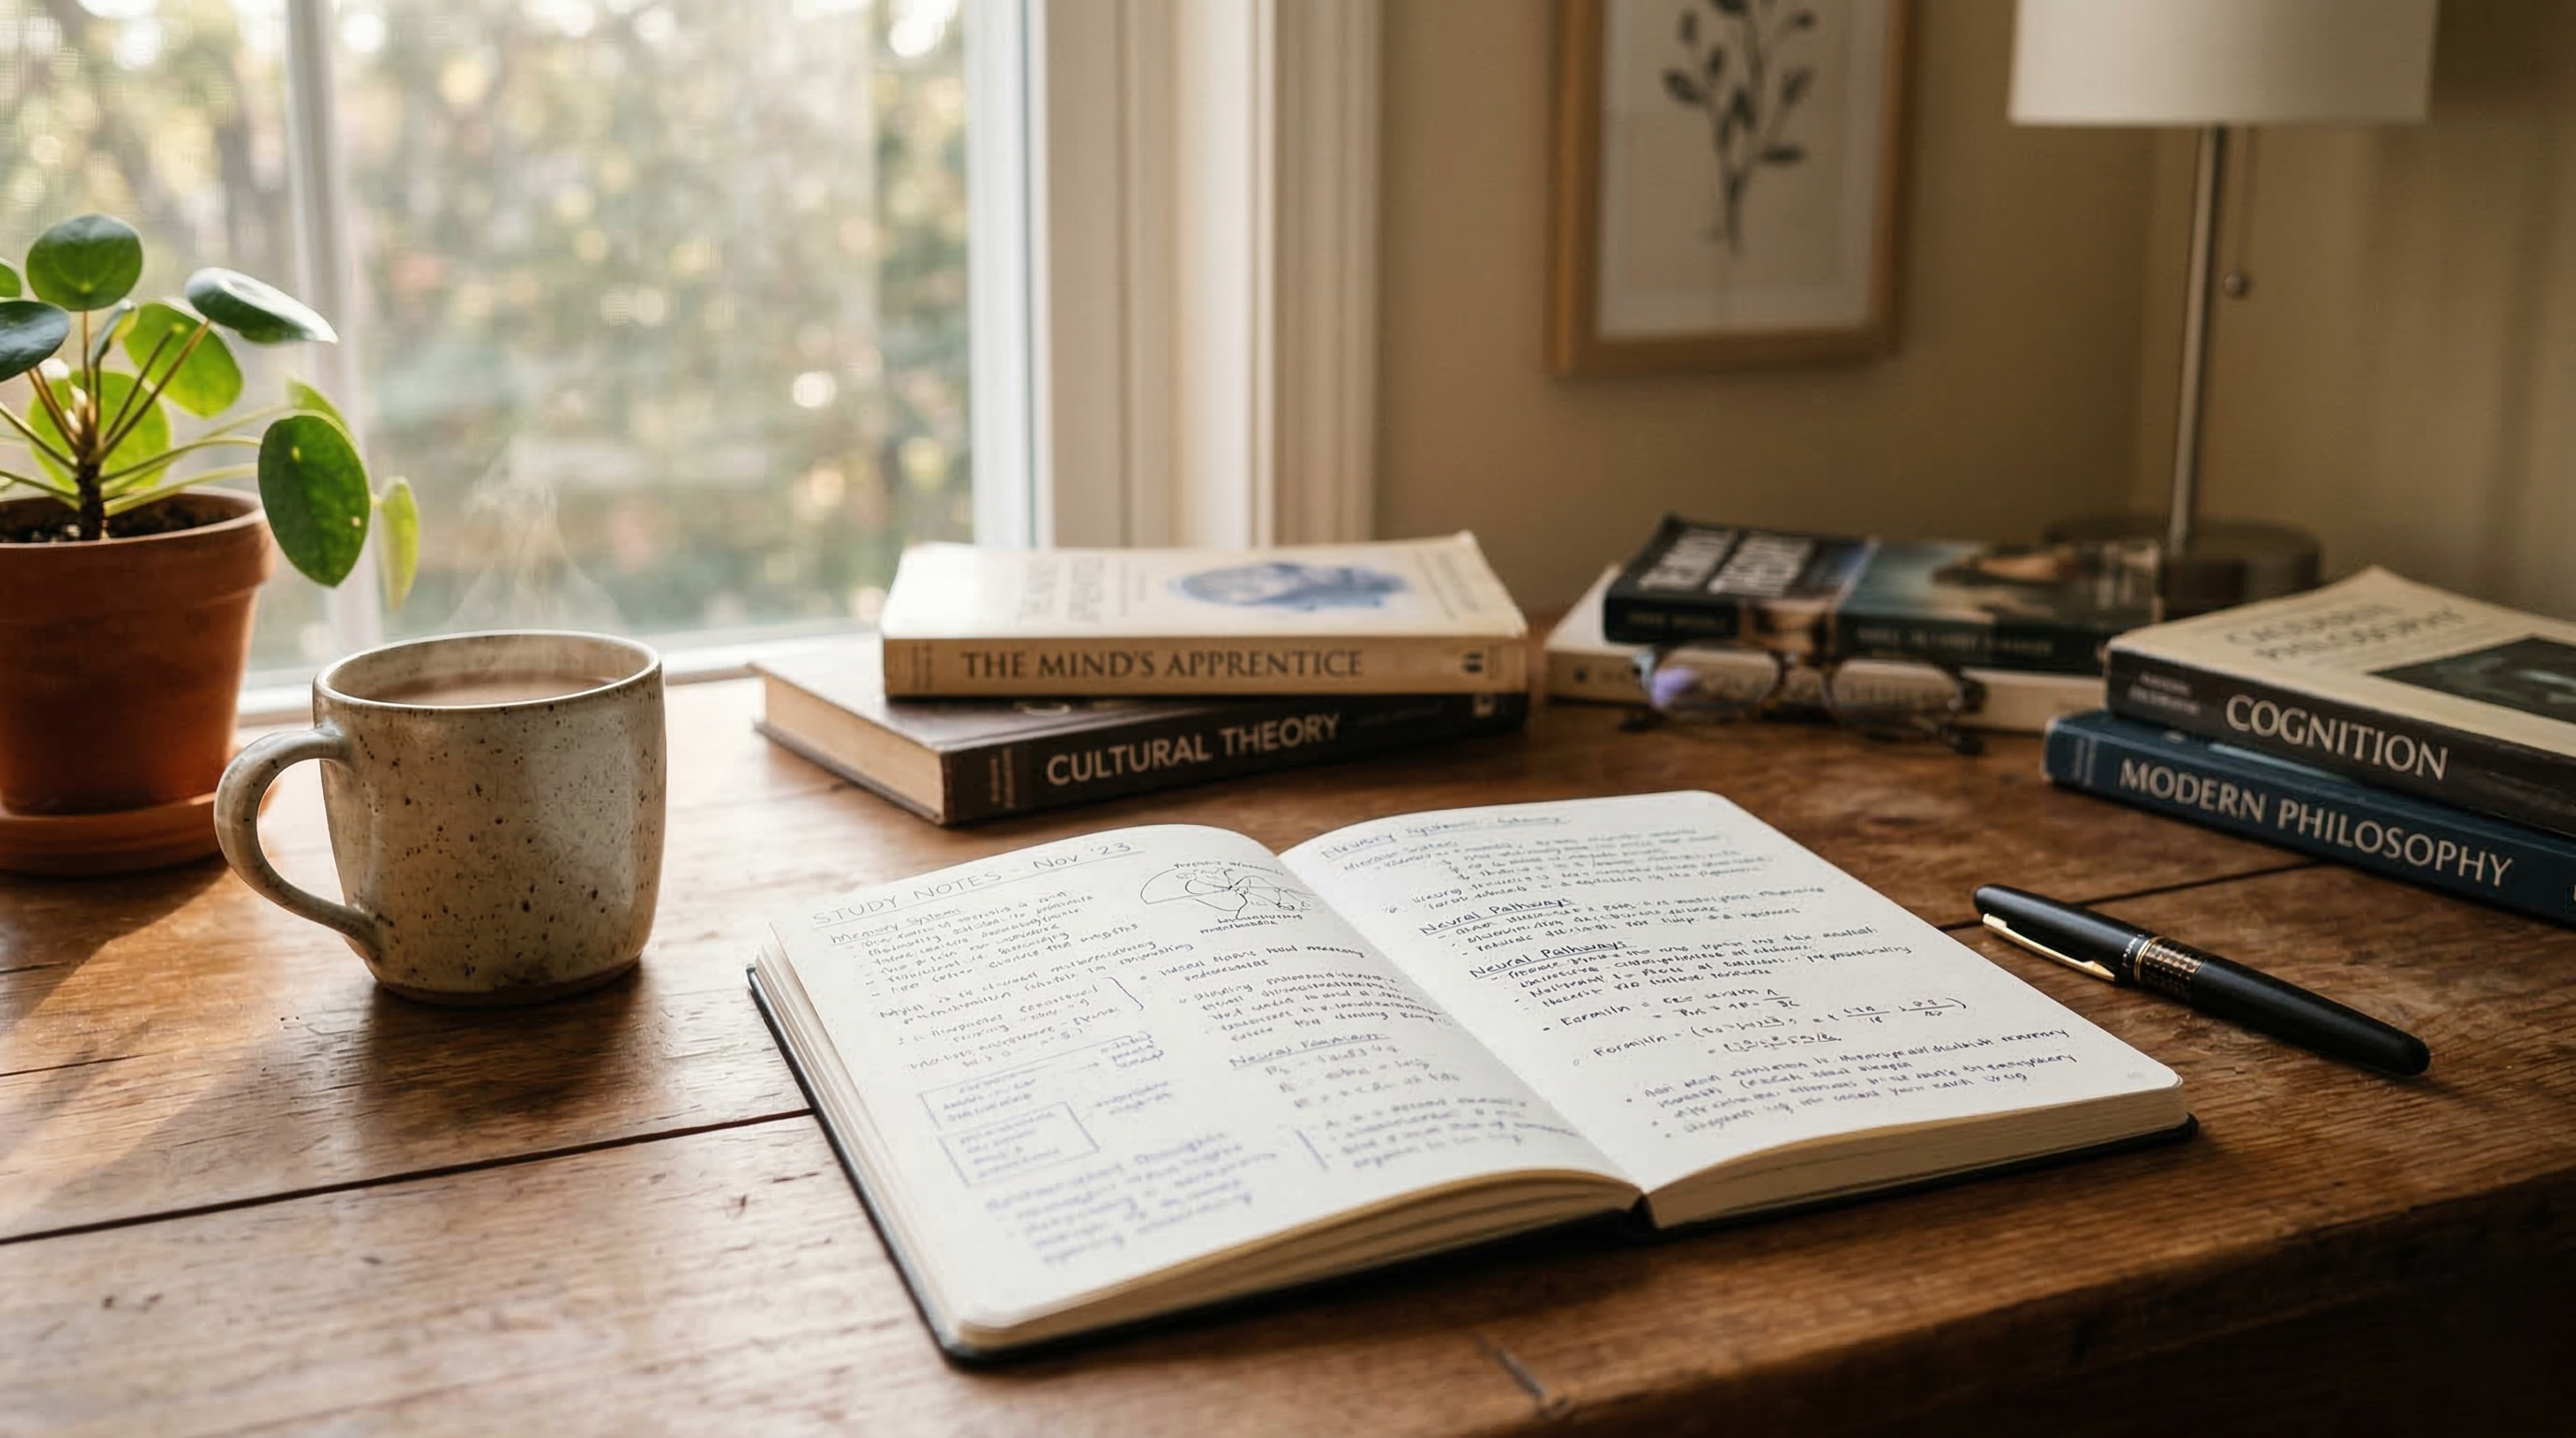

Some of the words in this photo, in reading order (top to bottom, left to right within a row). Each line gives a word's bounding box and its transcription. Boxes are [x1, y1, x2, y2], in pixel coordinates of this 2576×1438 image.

[961, 651, 1026, 679] THE
[1036, 650, 1156, 679] MIND'S
[1164, 648, 1364, 678] APPRENTICE
[1046, 734, 1213, 786] CULTURAL
[1220, 713, 1340, 756] THEORY
[2225, 694, 2449, 781] COGNITION
[2119, 757, 2268, 825] MODERN
[2276, 800, 2513, 888] PHILOSOPHY
[812, 894, 898, 926] STUDY
[913, 871, 1003, 901] NOTES
[1032, 853, 1079, 870] Nov
[1090, 842, 1132, 856] '23
[1419, 911, 1482, 934] Neural
[1488, 897, 1574, 915] Pathways
[1469, 954, 1532, 977] Neural
[1540, 940, 1628, 960] Pathways
